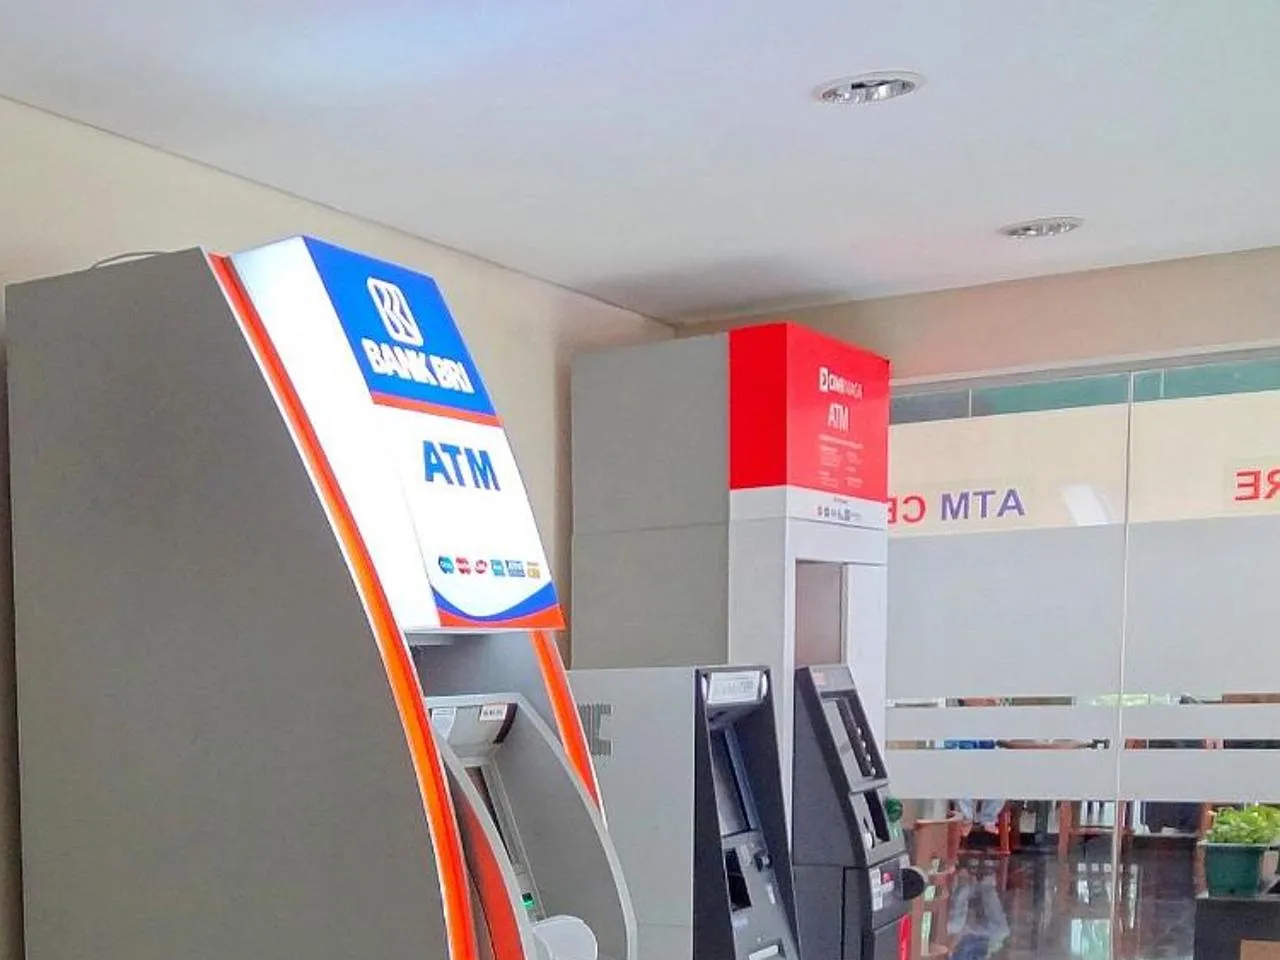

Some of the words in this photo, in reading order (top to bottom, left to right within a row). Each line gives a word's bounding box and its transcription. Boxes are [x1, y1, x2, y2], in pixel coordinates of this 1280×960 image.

[360, 337, 437, 387] BANK
[429, 351, 476, 394] BRI
[827, 402, 850, 433] ATM
[422, 439, 501, 492] ATM
